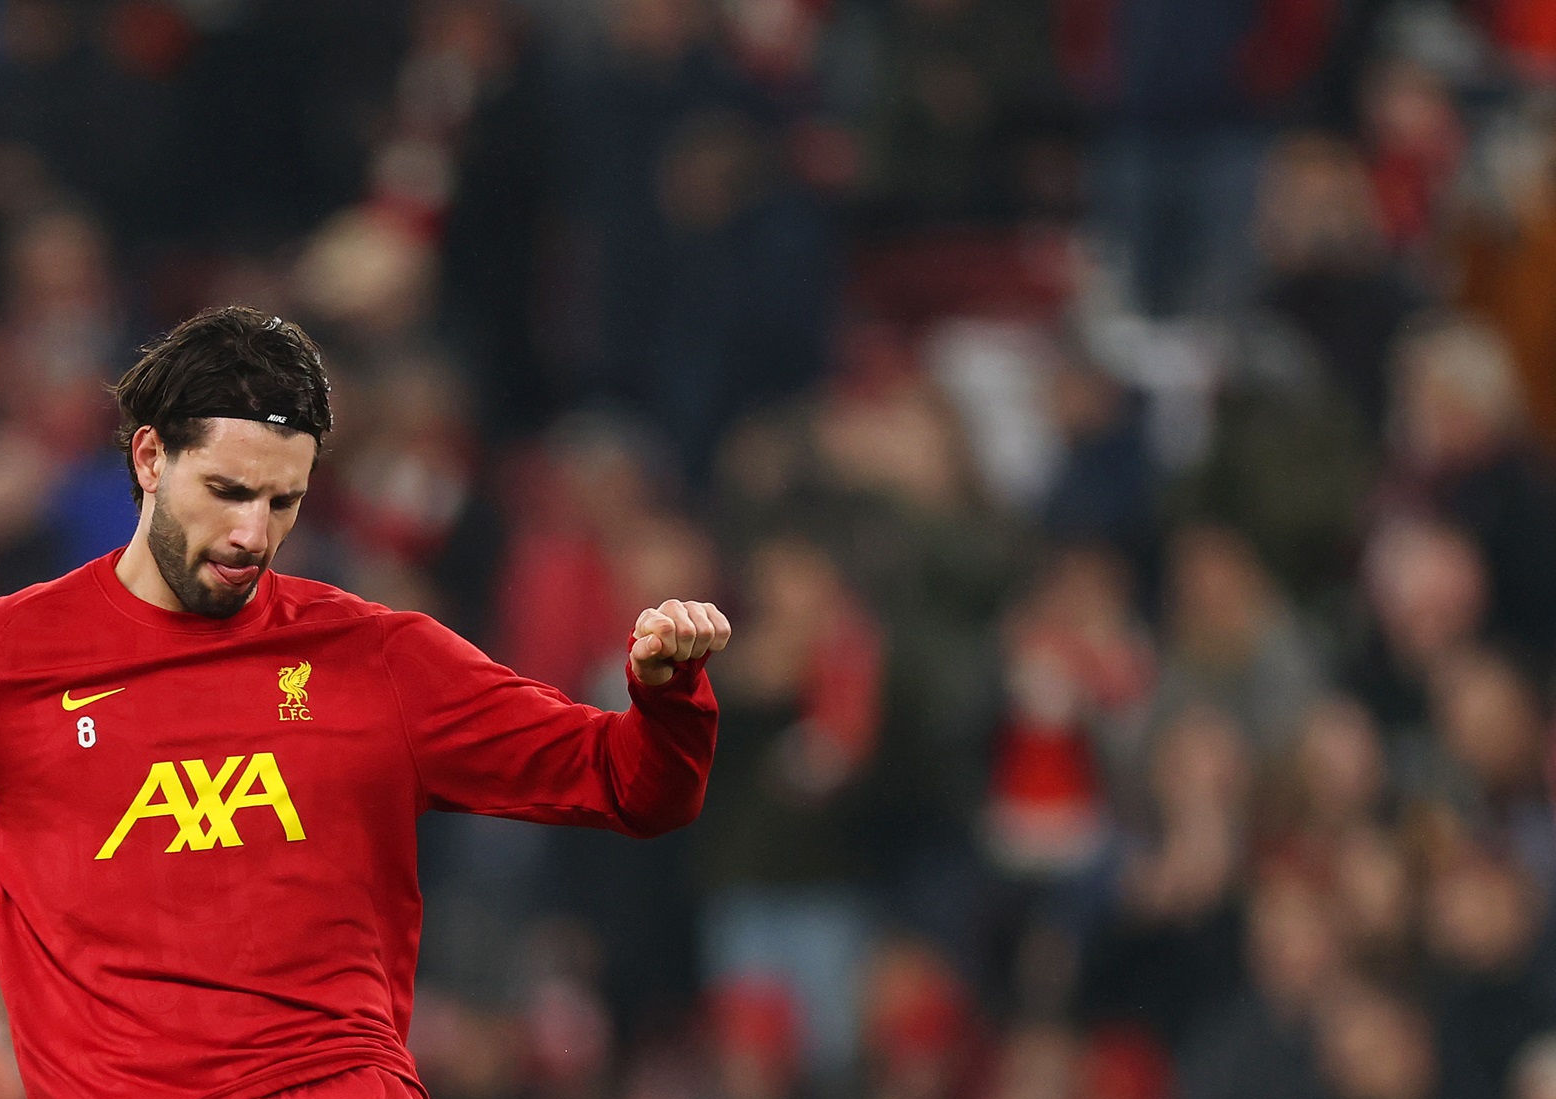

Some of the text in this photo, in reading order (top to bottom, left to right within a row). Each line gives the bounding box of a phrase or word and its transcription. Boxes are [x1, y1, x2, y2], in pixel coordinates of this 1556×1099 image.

[268, 413, 288, 424] NIKE
[278, 708, 314, 721] L.F.C.
[76, 716, 97, 748] 8
[94, 752, 306, 860] AXA
